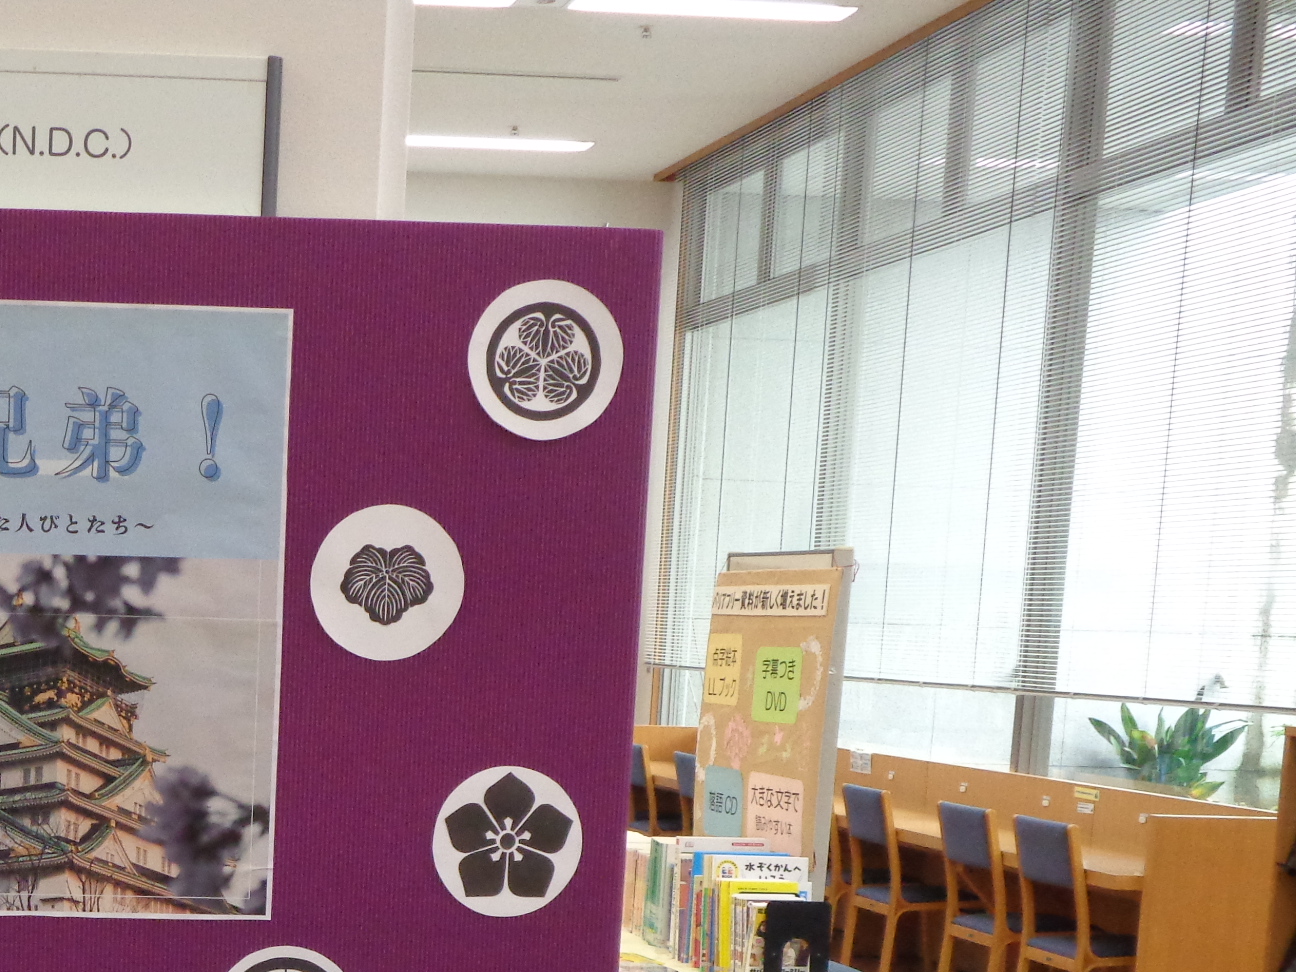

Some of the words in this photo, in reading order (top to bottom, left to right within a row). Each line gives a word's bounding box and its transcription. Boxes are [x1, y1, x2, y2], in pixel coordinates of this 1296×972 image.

[712, 648, 738, 667] 点字絵本
[762, 659, 797, 681] 字幕つき
[765, 690, 787, 712] DVD
[750, 784, 800, 813] 大きな文字で
[744, 862, 802, 873] 水ぞくかんへ
